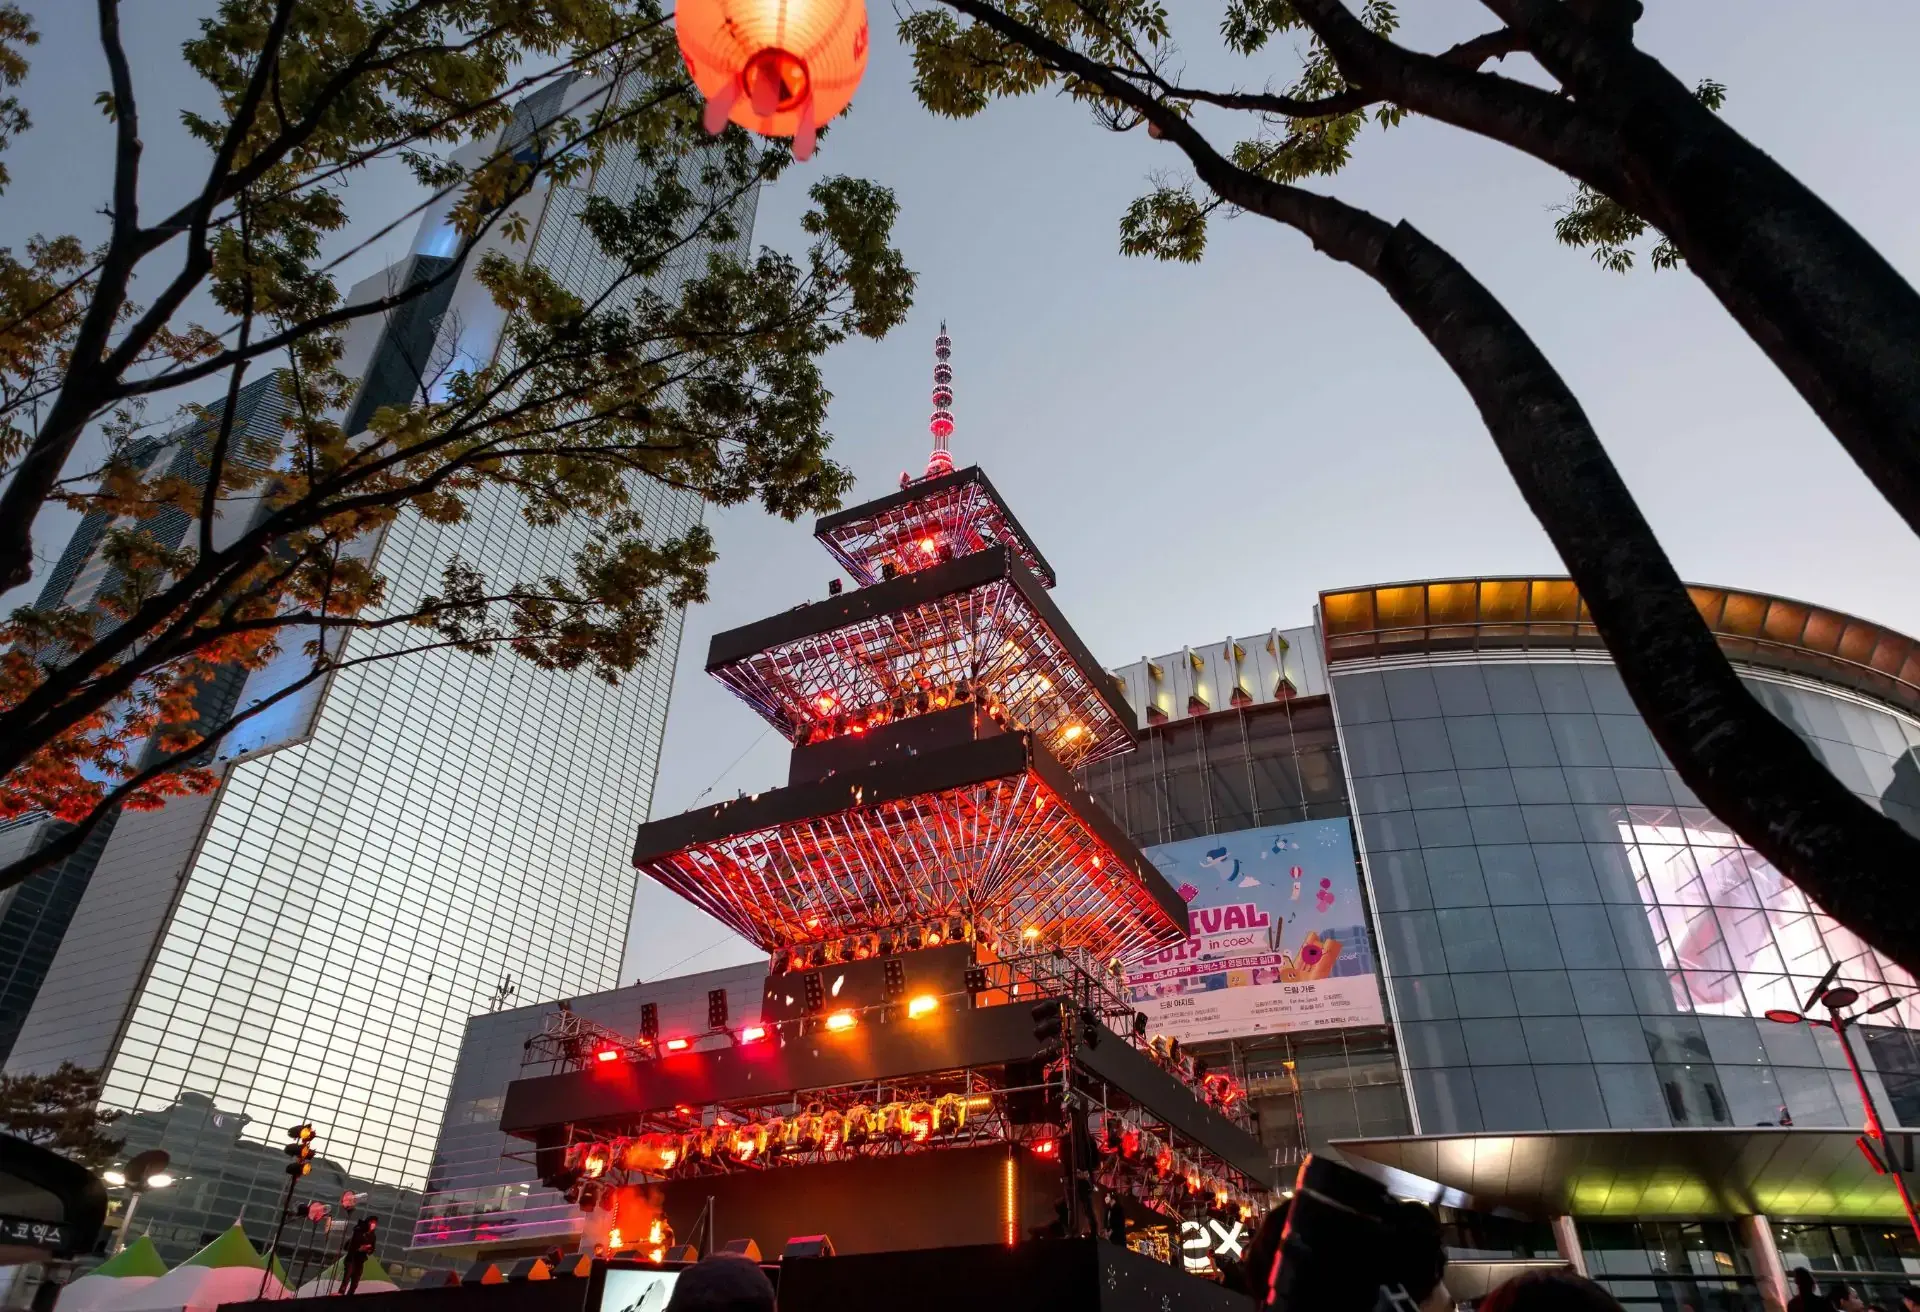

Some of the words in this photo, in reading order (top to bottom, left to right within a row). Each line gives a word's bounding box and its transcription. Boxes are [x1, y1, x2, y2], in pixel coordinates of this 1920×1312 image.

[1209, 941, 1220, 950] in
[1223, 934, 1254, 948] coex
[1284, 986, 1299, 994] 드림
[1160, 1000, 1173, 1010] 드림
[12, 1223, 61, 1243] 코엑스
